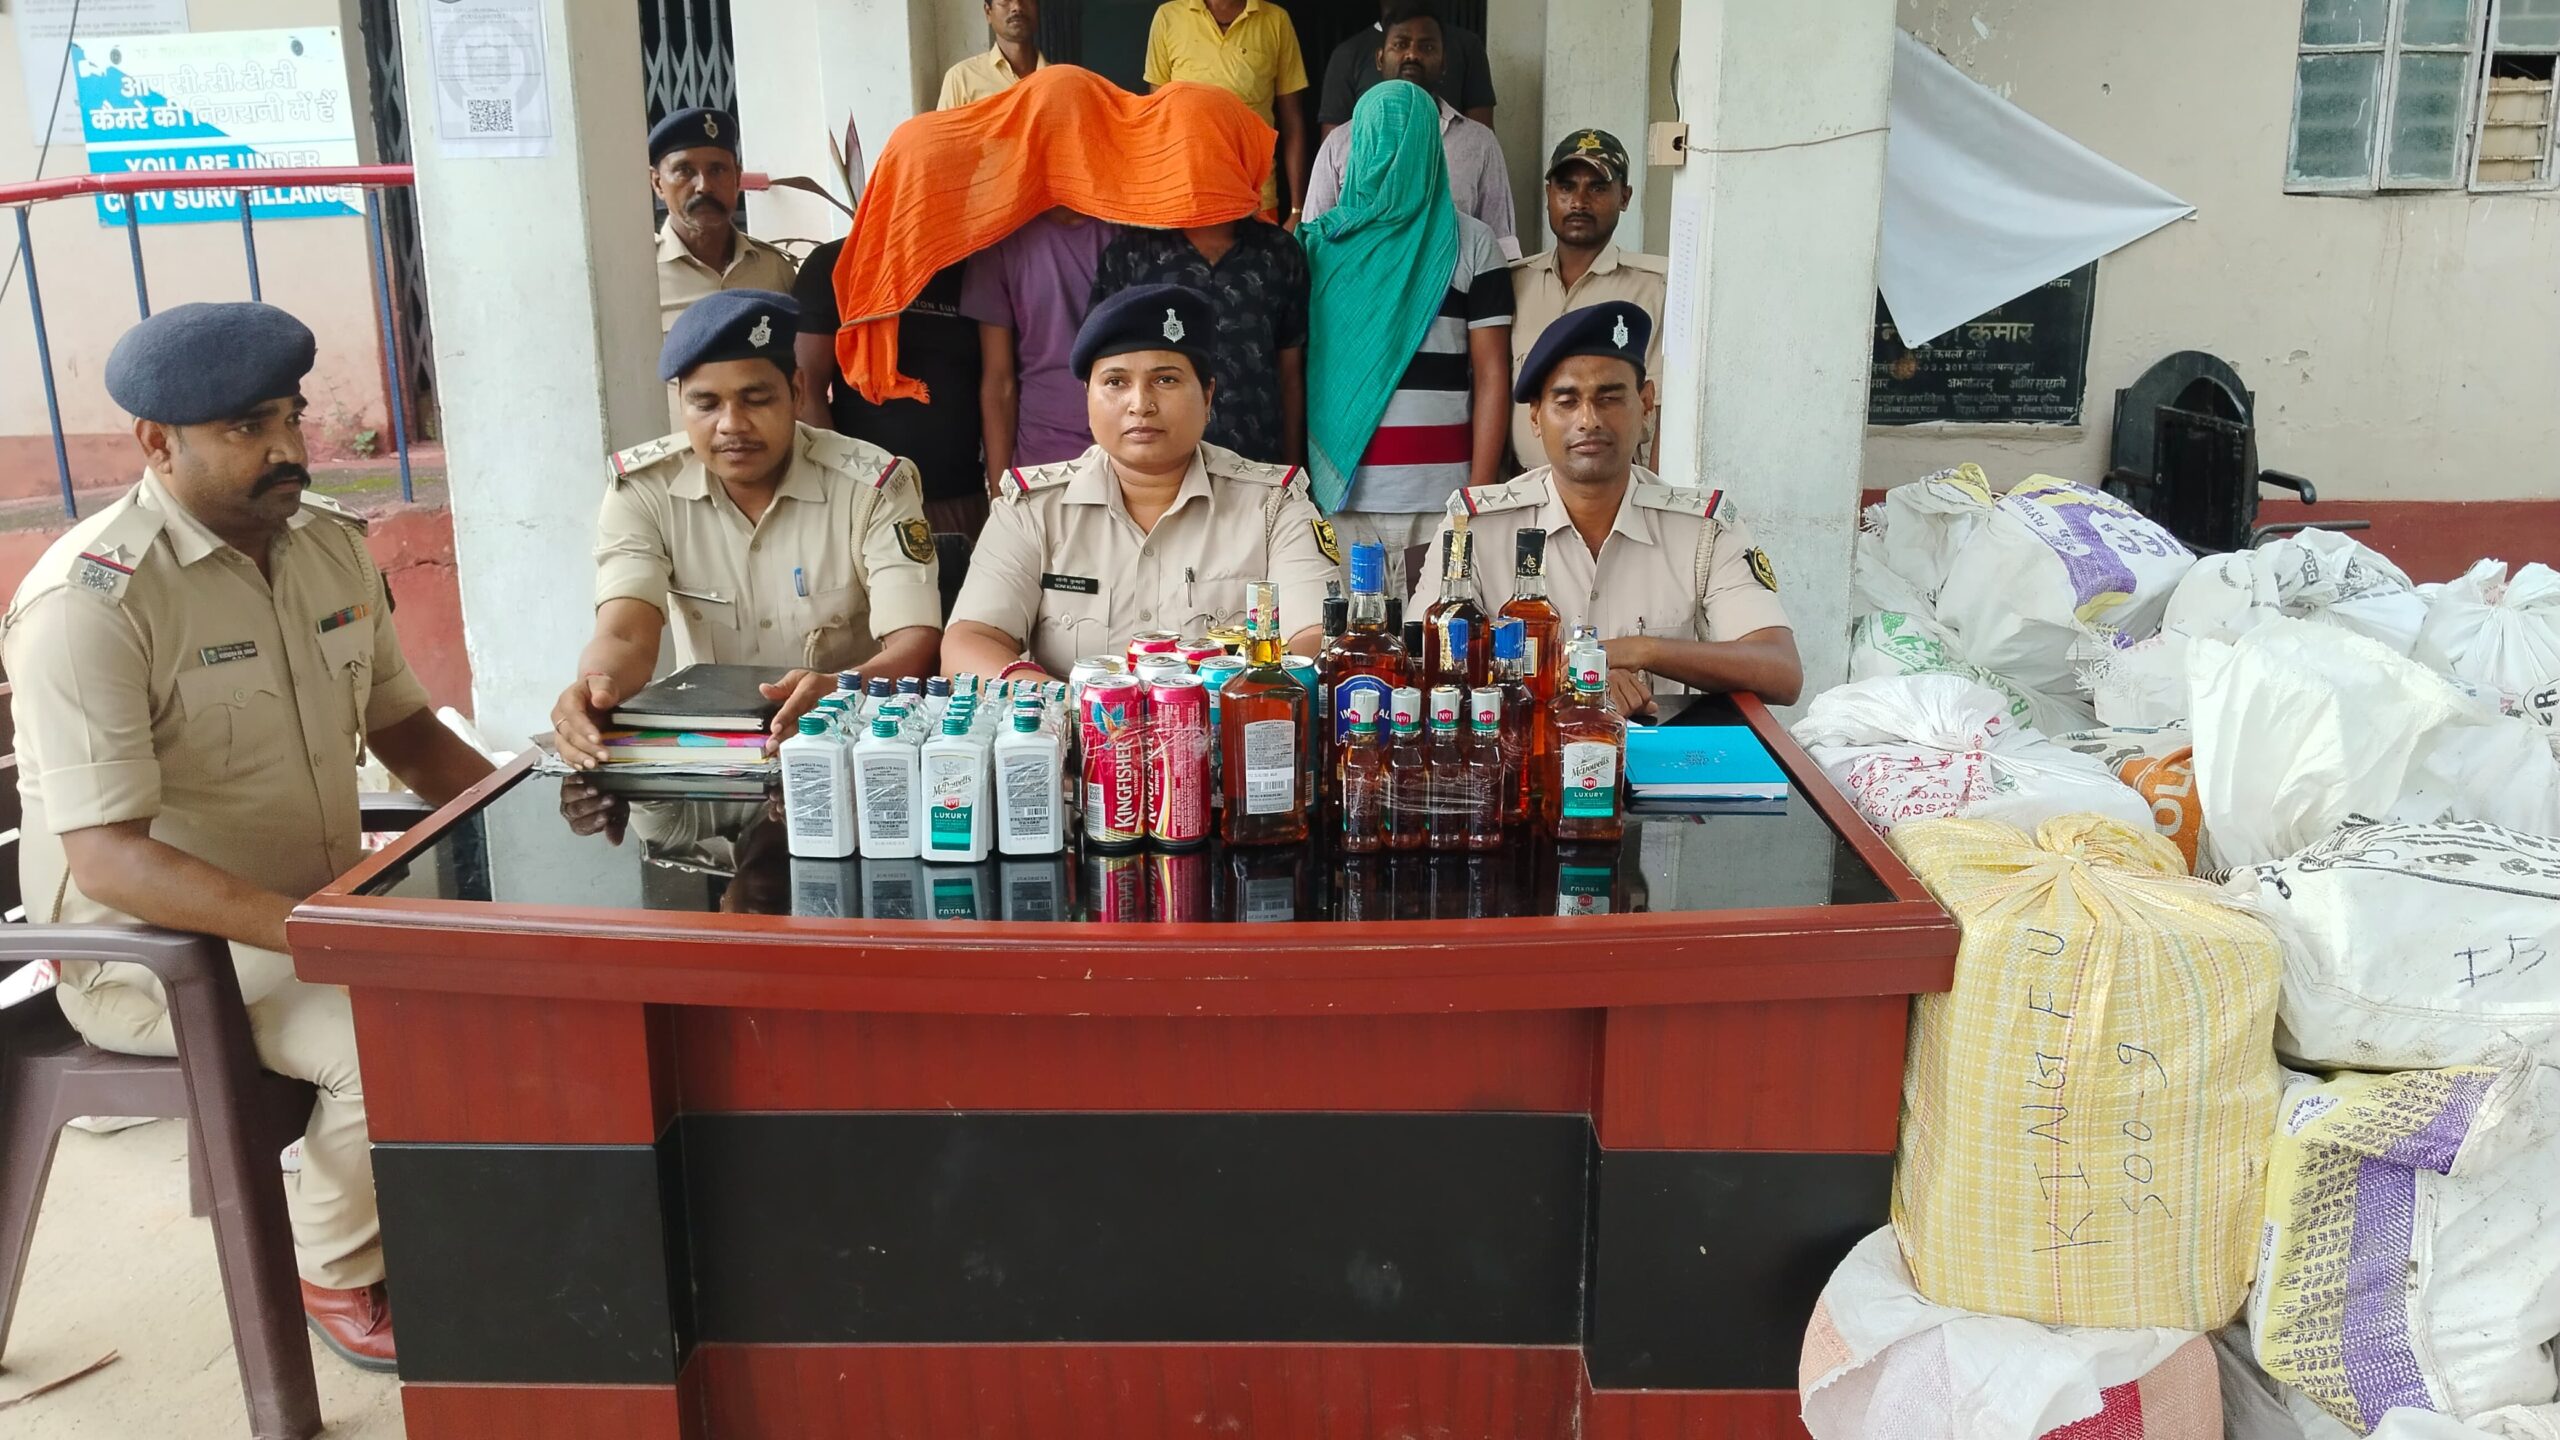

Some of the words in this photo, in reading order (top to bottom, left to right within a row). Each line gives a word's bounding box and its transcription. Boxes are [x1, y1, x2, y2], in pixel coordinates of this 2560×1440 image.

[121, 73, 164, 97] आप
[90, 100, 148, 131] कैमरे
[153, 100, 185, 127] की
[125, 157, 180, 171] YOU
[184, 155, 231, 170] ARE
[237, 151, 320, 169] UNDER
[104, 189, 165, 213] CTV
[174, 184, 356, 210] SURVILLANCE
[1966, 323, 2034, 349] कुमार
[1115, 735, 1134, 828] KINGFISHER
